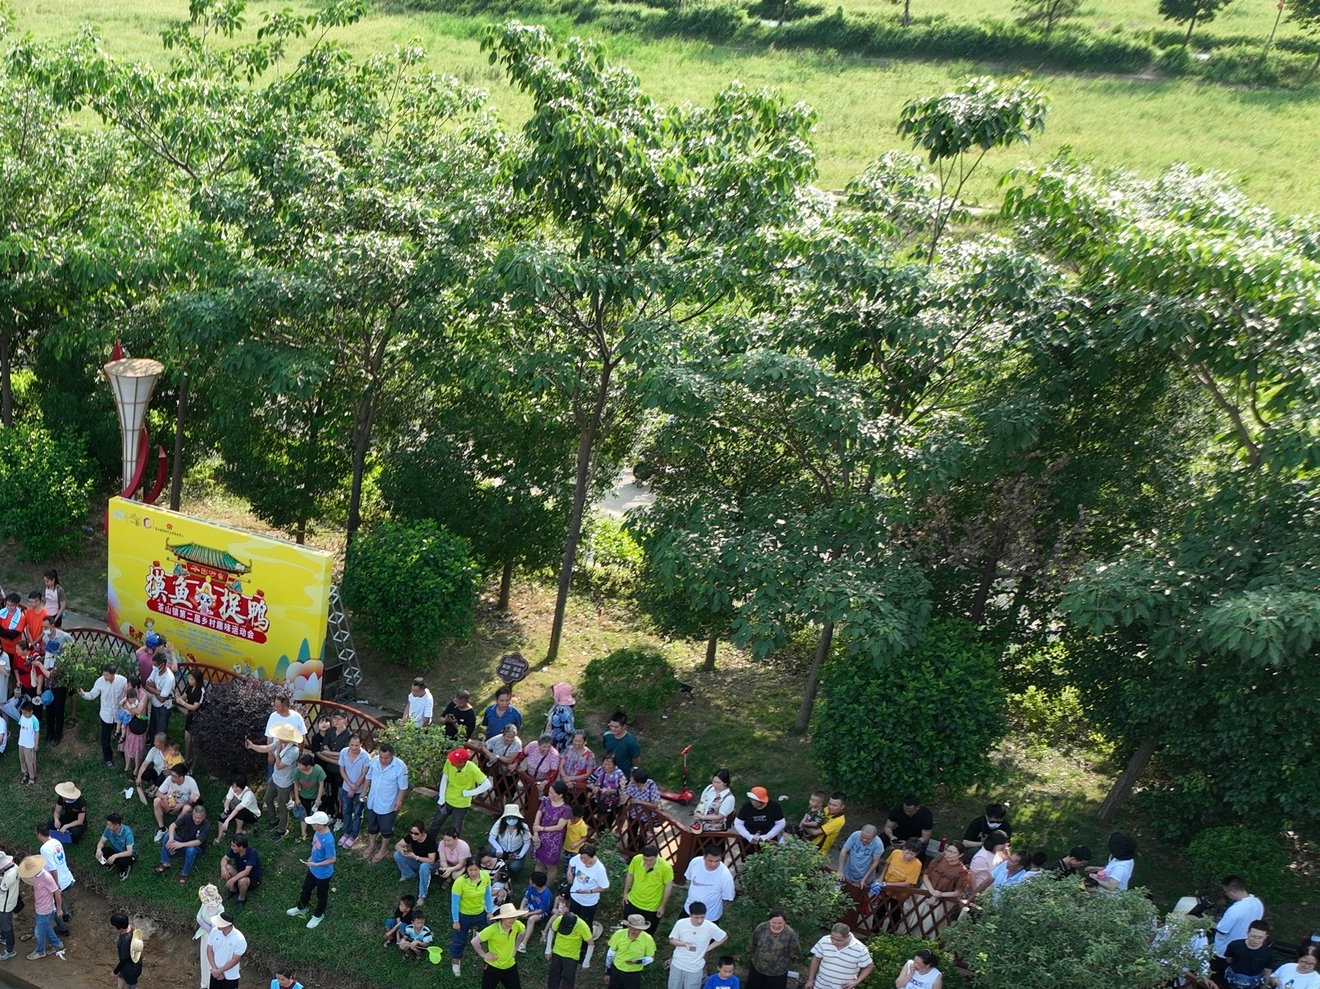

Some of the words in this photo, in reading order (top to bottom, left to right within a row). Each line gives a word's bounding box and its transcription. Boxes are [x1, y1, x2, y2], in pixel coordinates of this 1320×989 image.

[146, 565, 194, 609] 摸鱼
[219, 587, 270, 633] 捉鸭
[157, 602, 255, 640] 茶山镇第二届乡村趣味运动会
